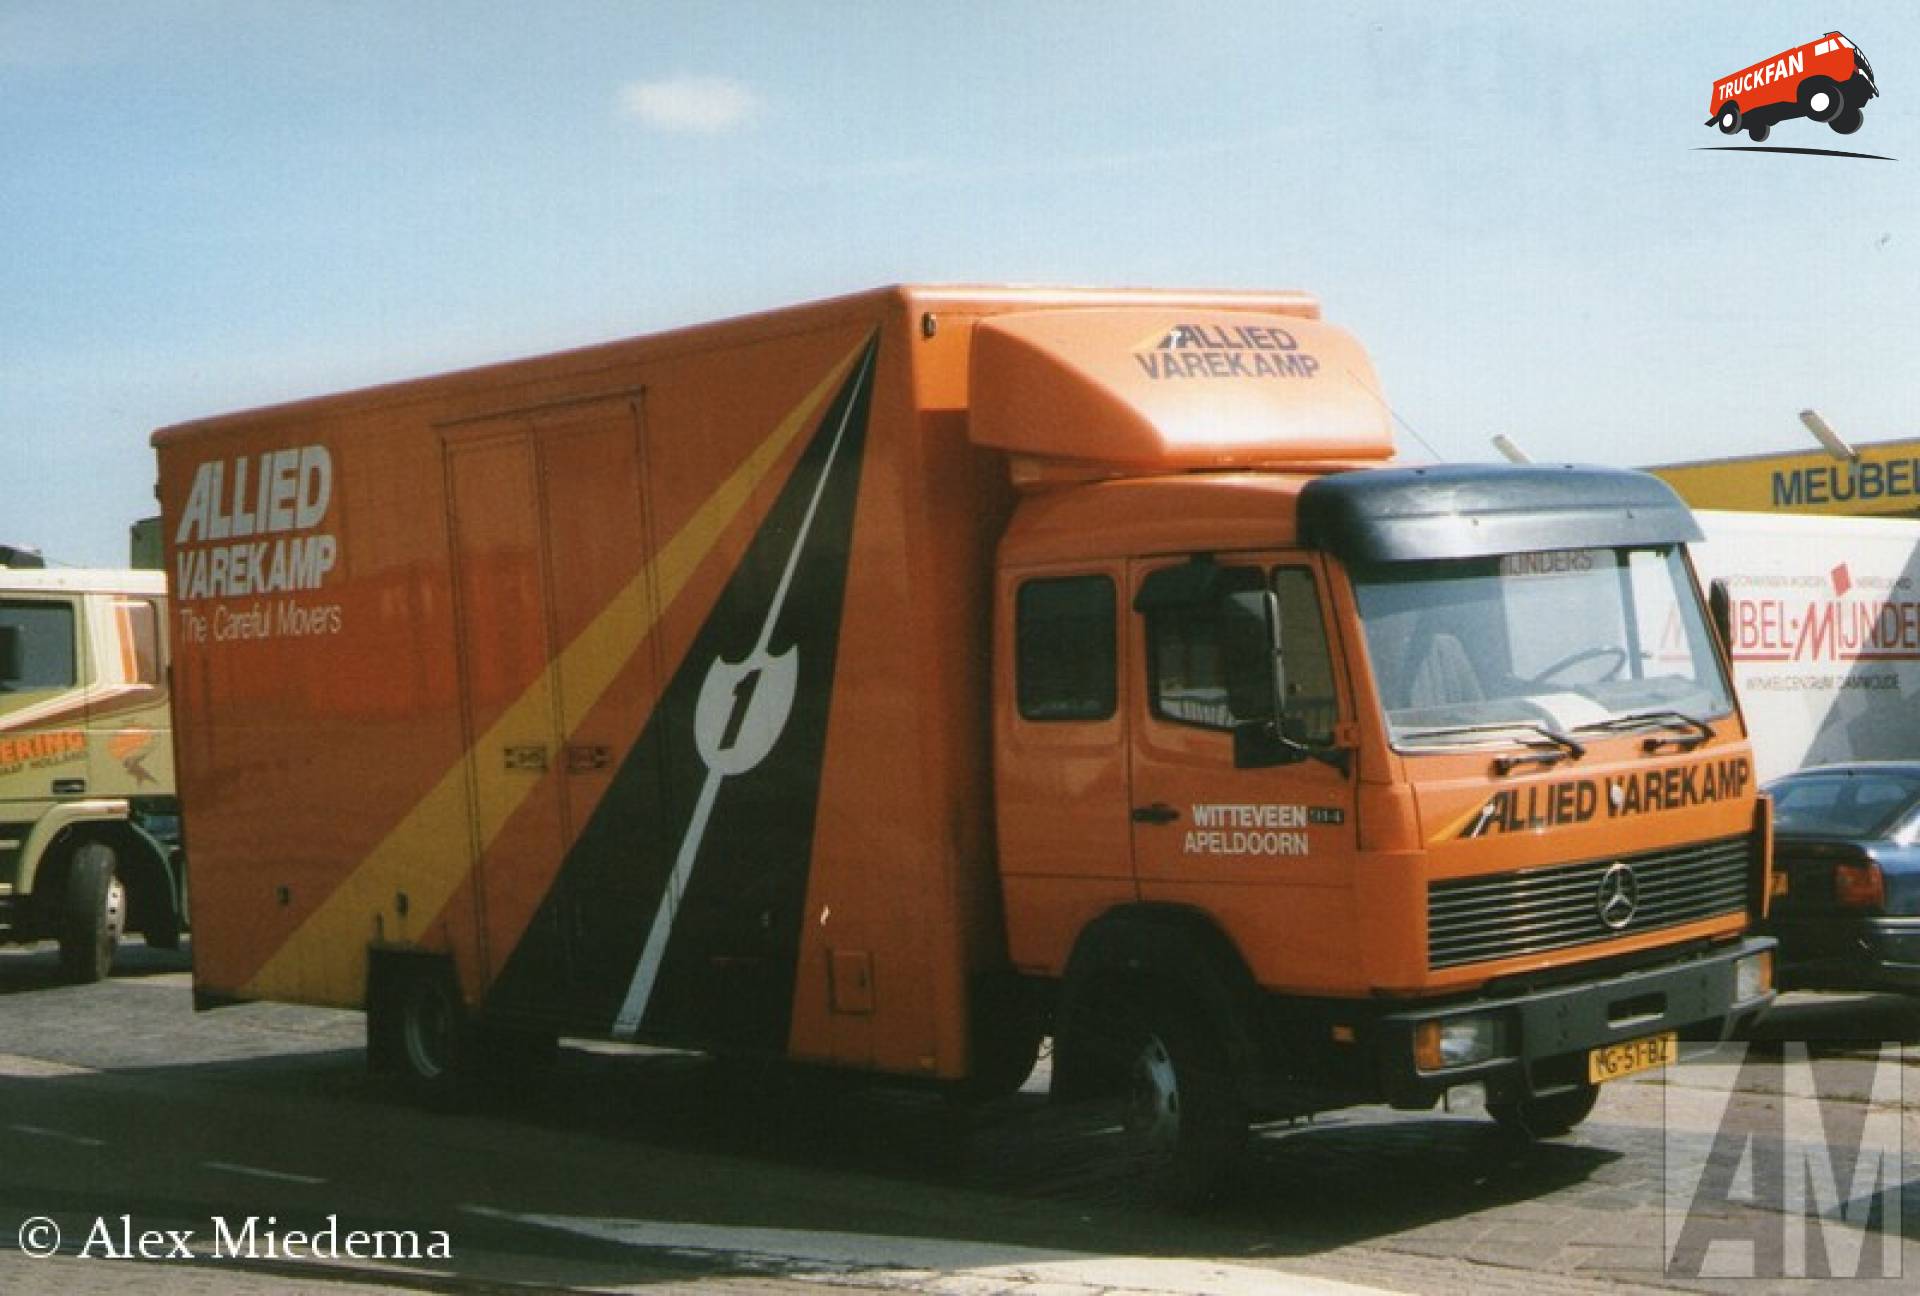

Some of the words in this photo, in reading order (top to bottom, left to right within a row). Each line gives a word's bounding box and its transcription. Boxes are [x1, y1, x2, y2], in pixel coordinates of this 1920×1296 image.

[1156, 324, 1298, 350] ALLIED
[1134, 351, 1321, 379] VAREKAMP
[175, 444, 333, 545] ALLIED
[177, 534, 337, 600] VAREKAMP
[179, 607, 208, 644] The
[214, 602, 270, 642] Careful
[276, 599, 342, 637] Movers
[717, 668, 762, 751] 1
[1192, 803, 1307, 828] WITTEVEEN
[1458, 778, 1597, 839] ALLIED
[1605, 757, 1749, 818] VAREKAMP
[1184, 832, 1309, 857] APELDOORN
